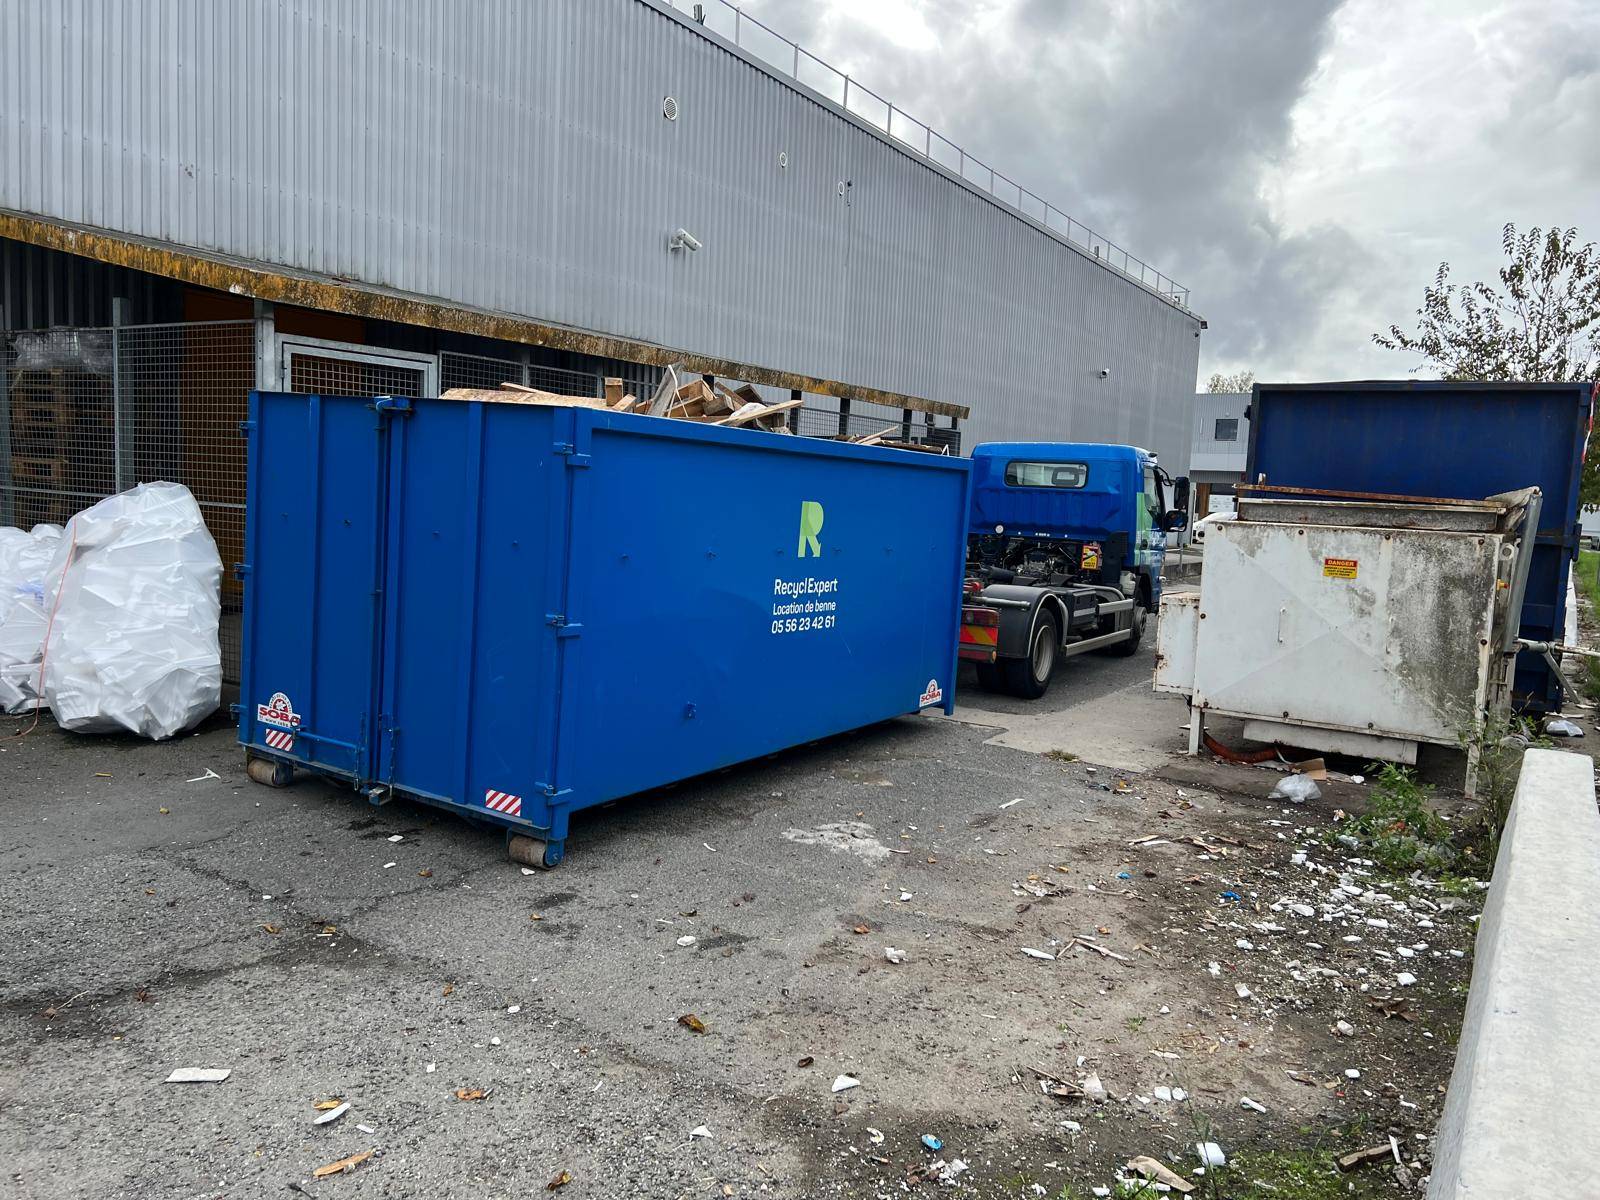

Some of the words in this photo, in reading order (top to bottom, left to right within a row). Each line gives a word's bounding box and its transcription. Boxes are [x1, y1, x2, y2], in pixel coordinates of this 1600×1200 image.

[798, 501, 824, 557] R
[773, 602, 803, 615] Location
[804, 600, 814, 613] de
[814, 599, 837, 612] benne
[771, 620, 784, 634] 05
[785, 618, 797, 633] 56
[798, 617, 811, 631] 23
[811, 616, 824, 630] 42
[824, 615, 836, 629] 61
[921, 691, 940, 702] SOBA
